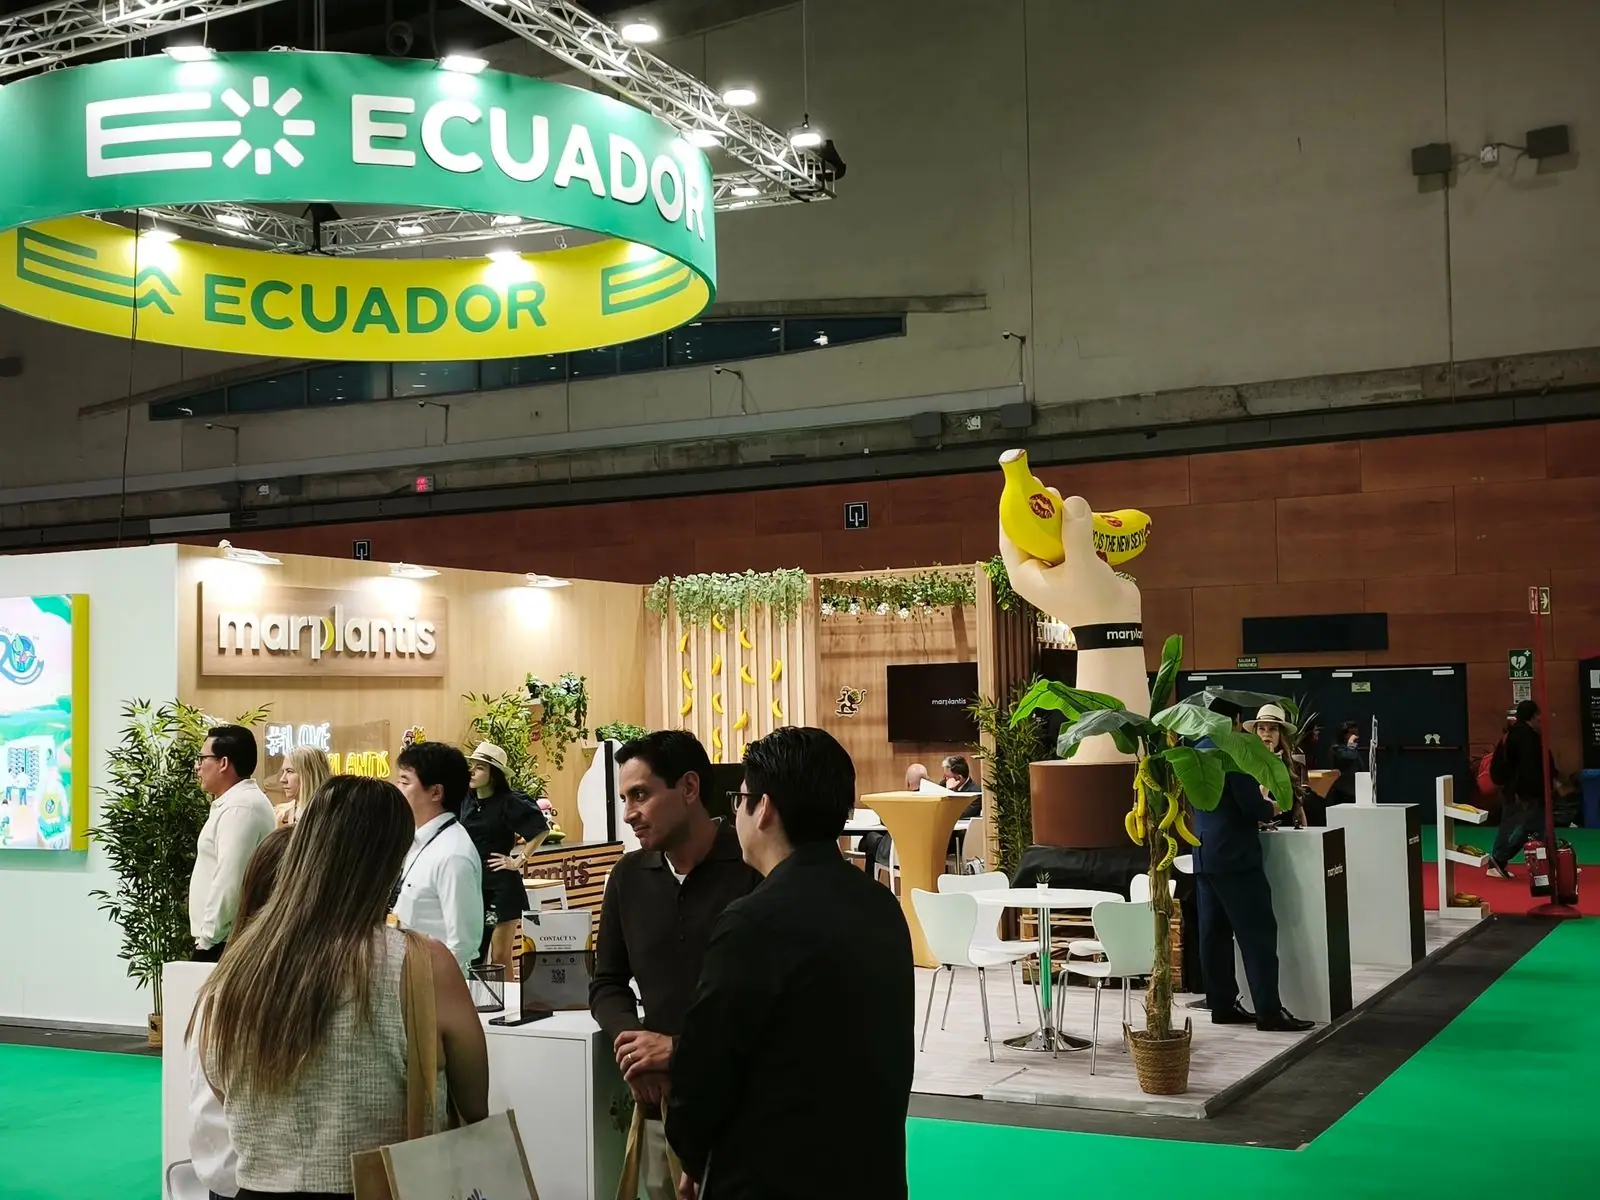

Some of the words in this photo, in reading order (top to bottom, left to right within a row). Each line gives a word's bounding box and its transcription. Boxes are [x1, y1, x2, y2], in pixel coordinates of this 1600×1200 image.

[352, 94, 706, 242] ECUADOR
[204, 273, 547, 333] ECUADOR
[1104, 534, 1116, 552] THE
[1116, 535, 1130, 552] NEW
[218, 604, 436, 659] marplantis
